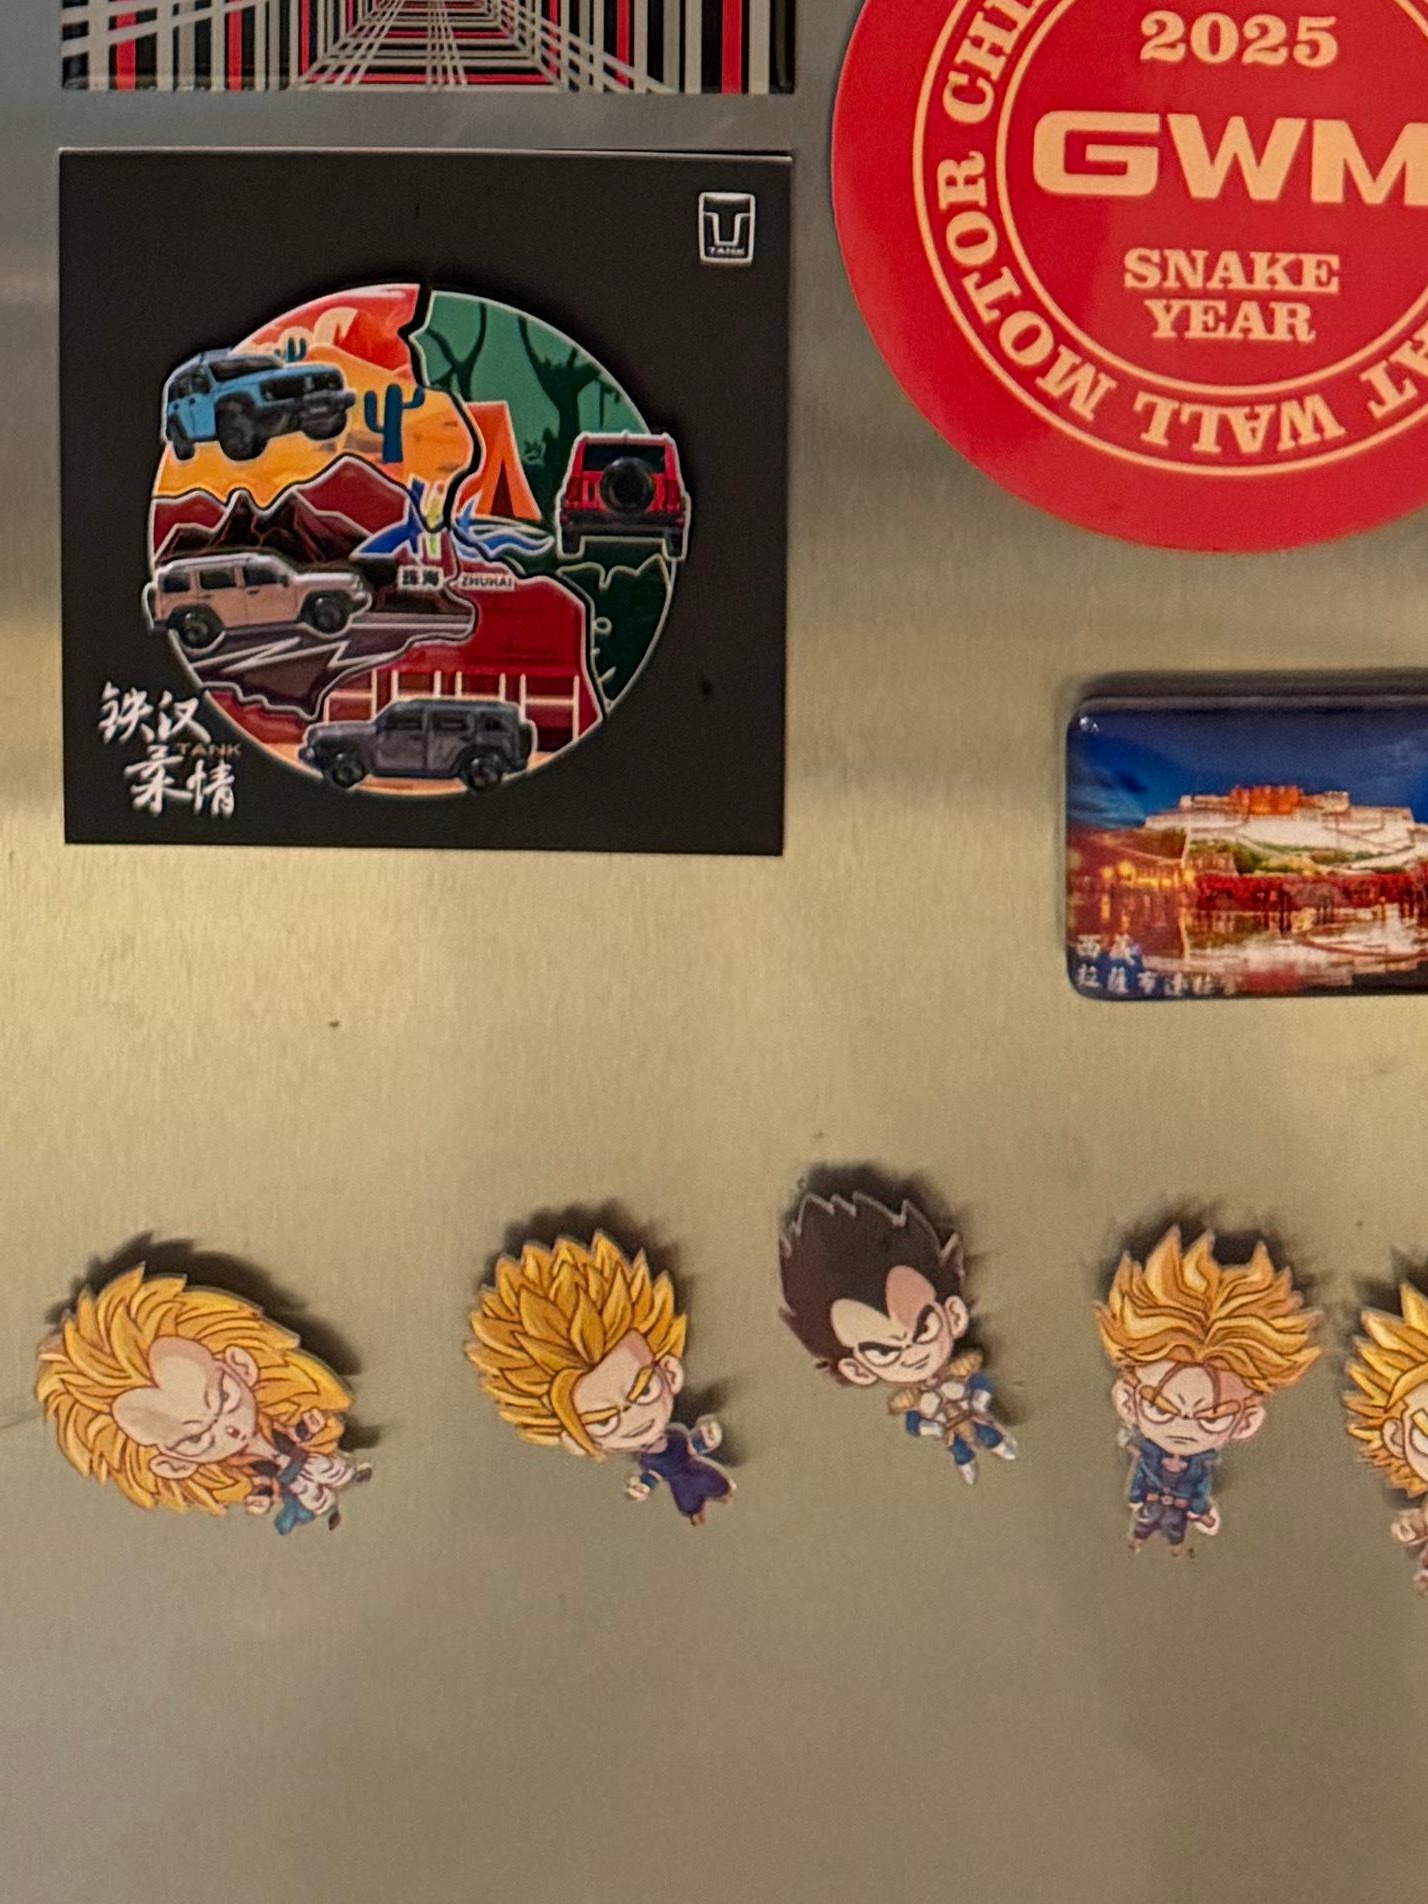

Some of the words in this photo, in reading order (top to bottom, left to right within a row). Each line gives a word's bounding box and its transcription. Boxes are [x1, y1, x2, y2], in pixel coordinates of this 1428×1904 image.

[1139, 10, 1341, 68] 2025
[937, 150, 1119, 421] MOTOR
[1123, 249, 1341, 295] SNAKE
[1144, 299, 1317, 343] YEAR
[1132, 394, 1347, 455] WALL
[461, 574, 513, 588] ZHUHAI
[176, 743, 242, 758] TANK
